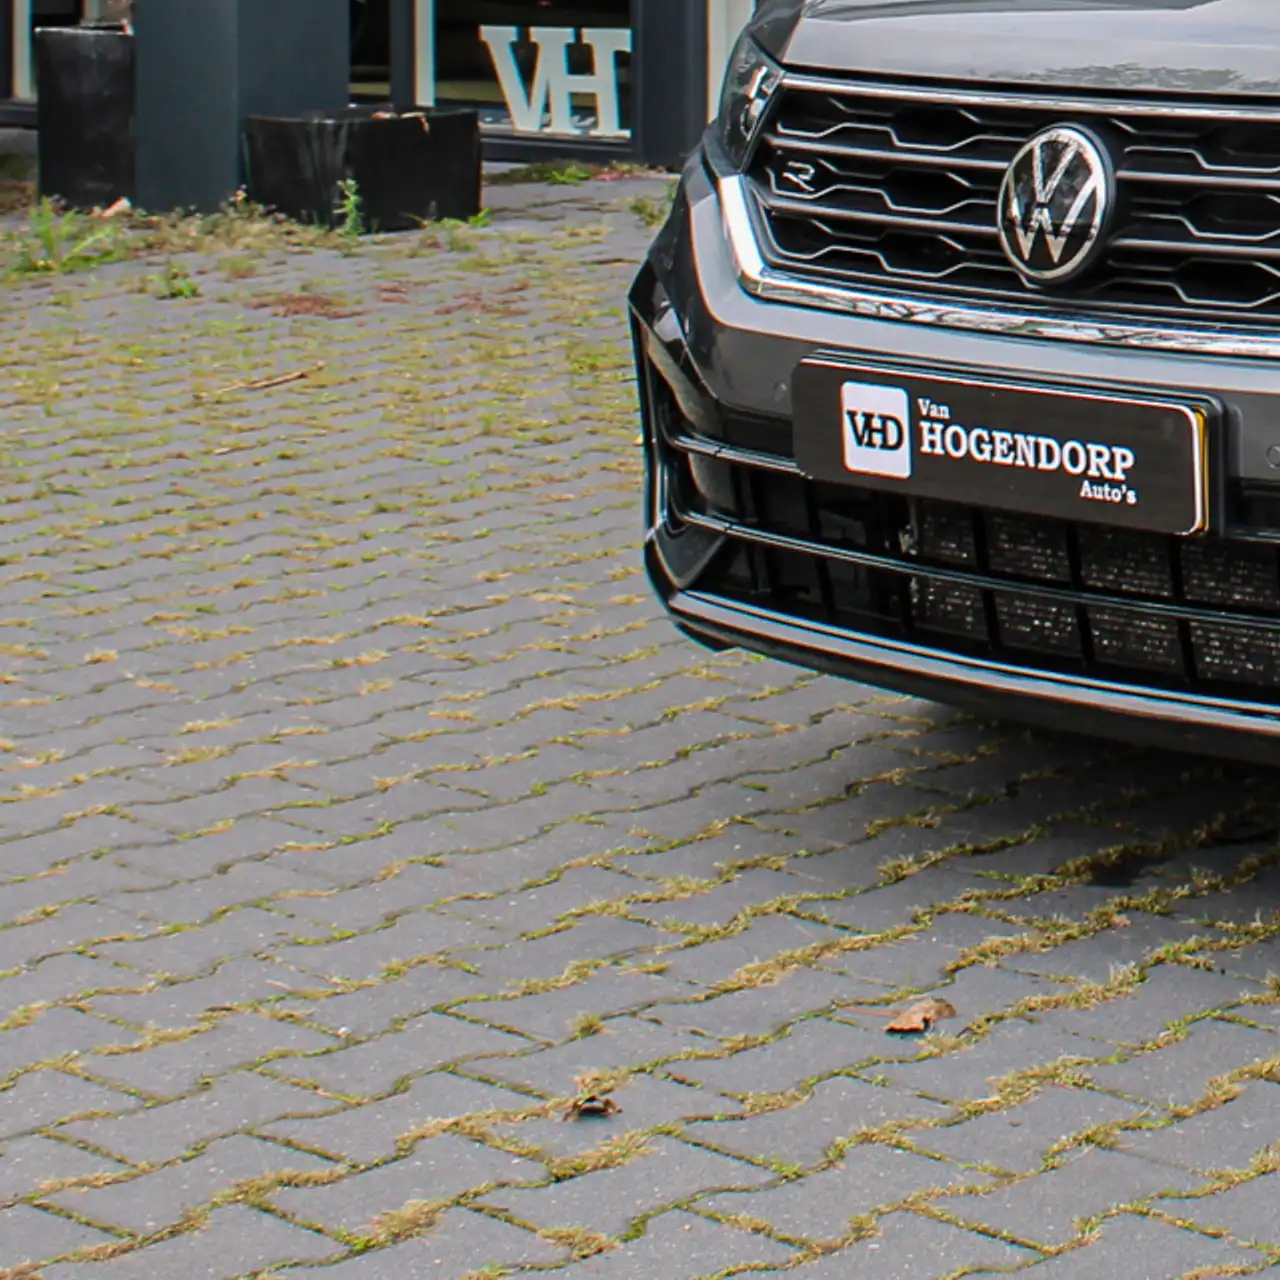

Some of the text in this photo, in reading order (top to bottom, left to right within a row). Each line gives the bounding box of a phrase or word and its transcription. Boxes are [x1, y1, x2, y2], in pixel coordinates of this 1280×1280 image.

[918, 398, 950, 421] Van
[919, 421, 1136, 481] HOGENDORP
[1079, 480, 1138, 506] Auto's
